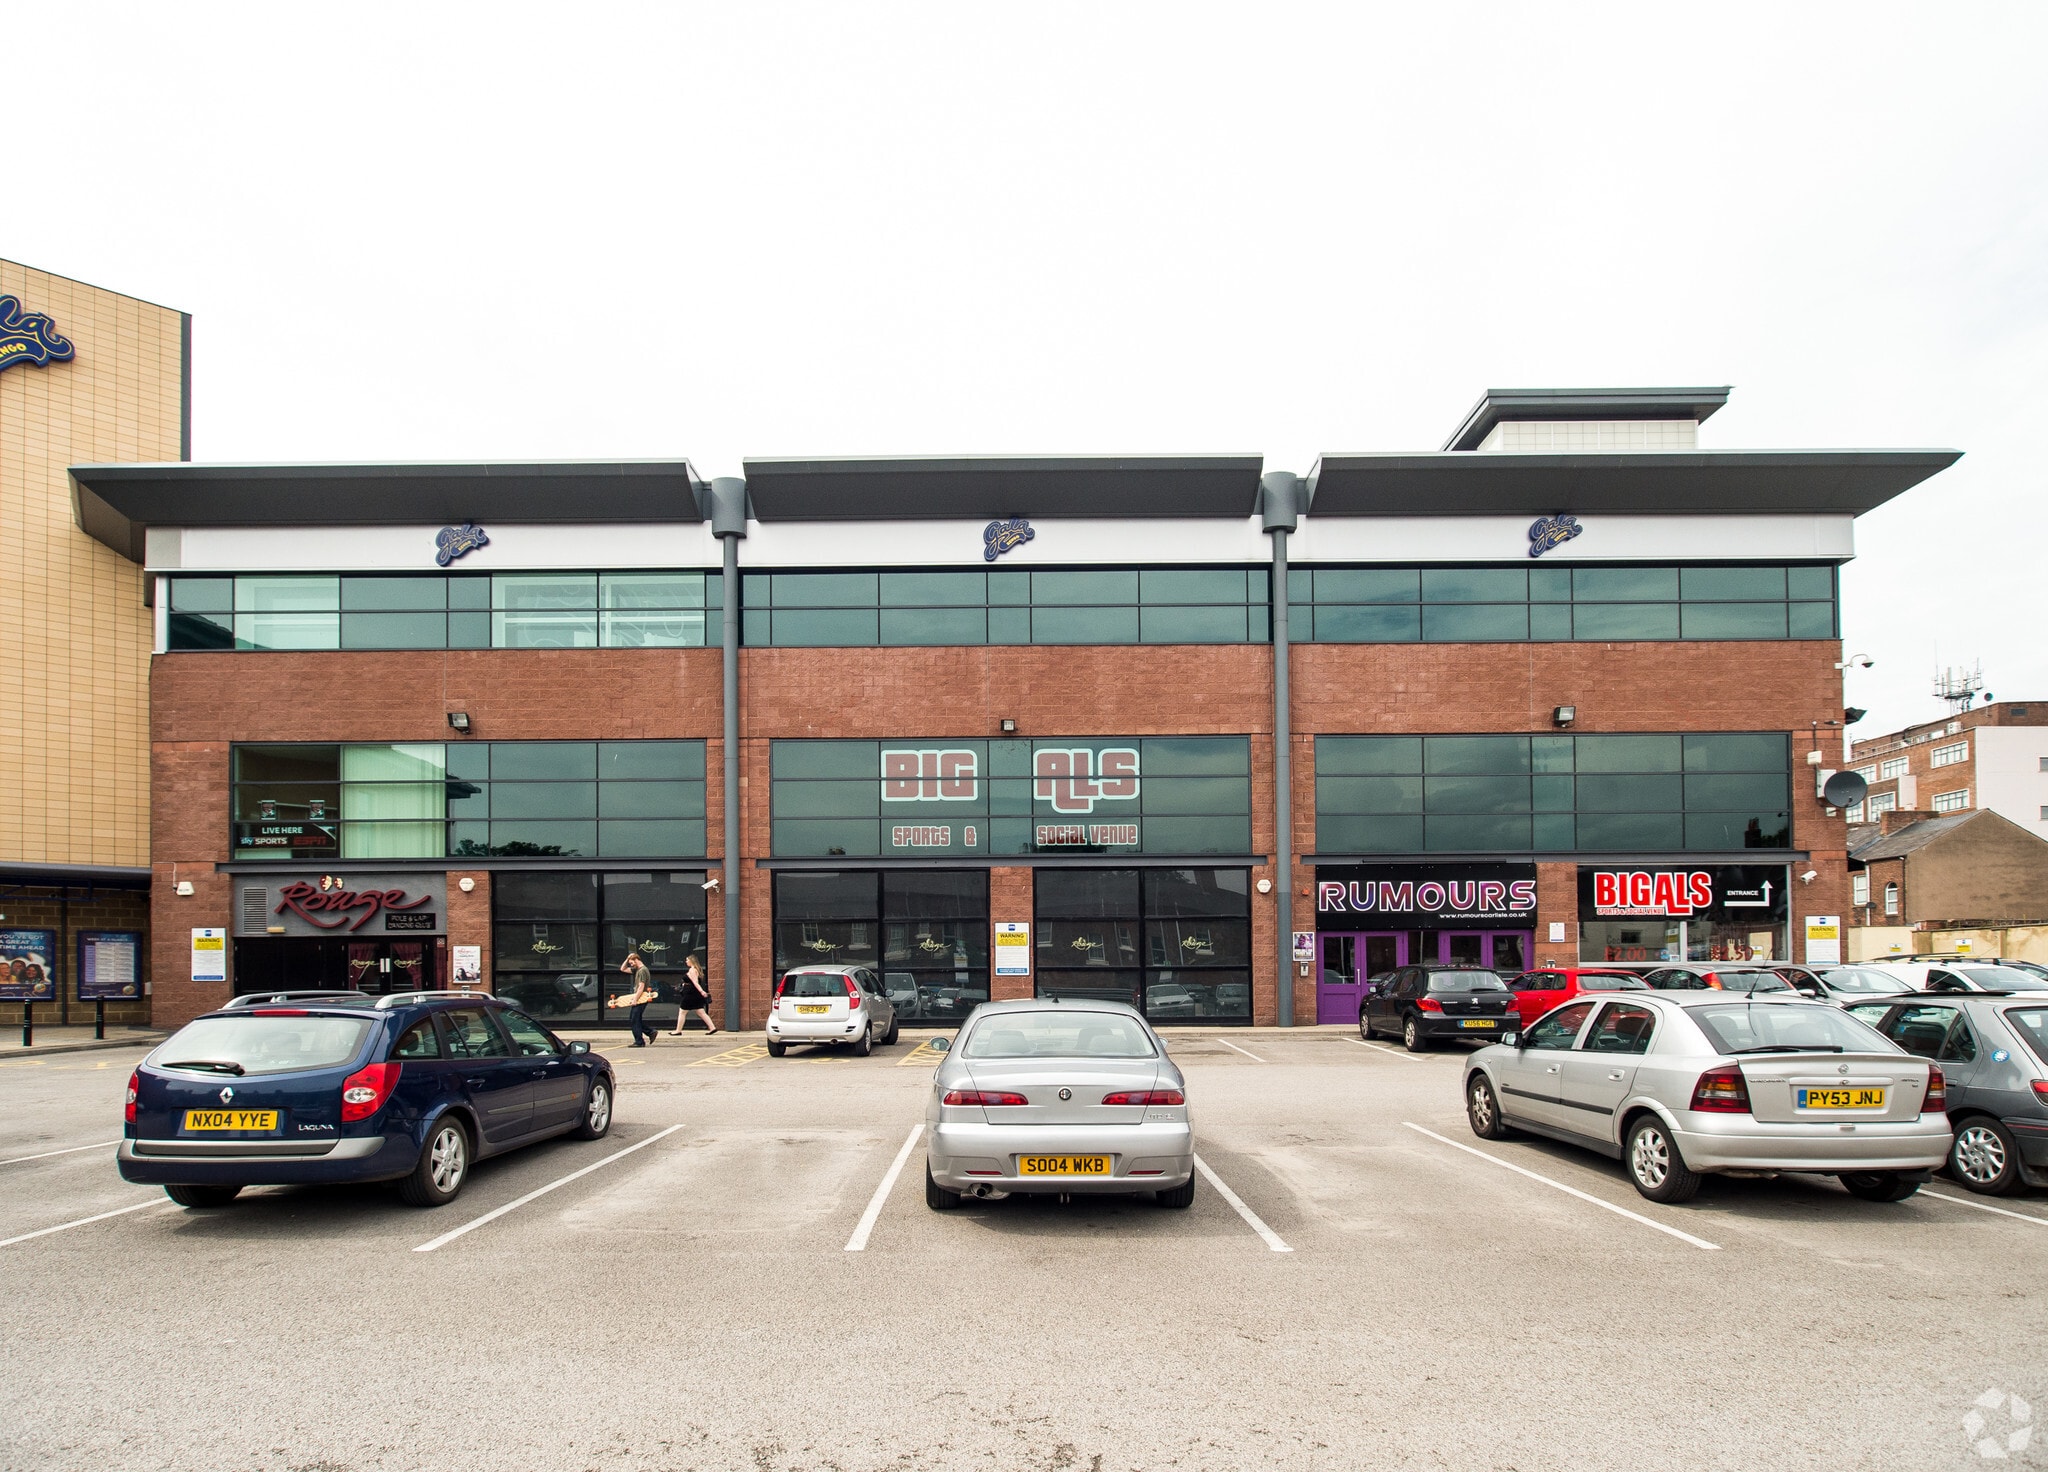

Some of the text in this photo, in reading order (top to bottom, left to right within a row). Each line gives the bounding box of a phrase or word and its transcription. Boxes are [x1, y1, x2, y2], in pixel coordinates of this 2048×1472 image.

[881, 750, 978, 800] BIG
[1033, 748, 1141, 813] ALS
[262, 826, 303, 834] LIVE HERE
[255, 836, 288, 845] SPORTS
[293, 836, 327, 846] ESPN
[1318, 880, 1537, 912] RUMOURS
[274, 880, 432, 932] Rouge
[1809, 1090, 1883, 1105] PY53 JNJ
[192, 1113, 271, 1127] NX04 YYE
[1073, 1158, 1104, 1172] WKB
